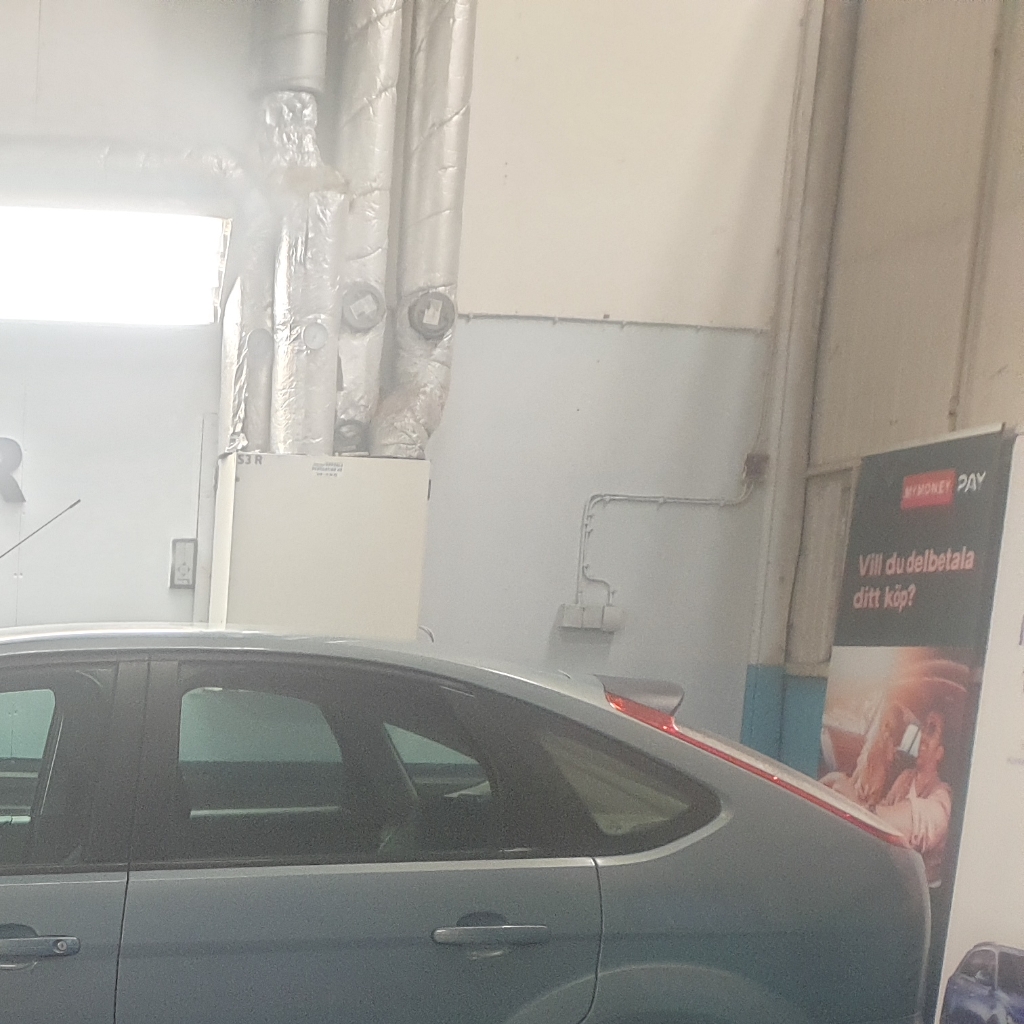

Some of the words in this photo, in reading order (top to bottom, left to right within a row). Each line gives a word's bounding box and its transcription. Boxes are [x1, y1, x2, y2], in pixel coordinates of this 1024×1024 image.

[957, 471, 987, 493] PAY
[859, 552, 883, 576] Vill
[885, 550, 905, 575] du
[906, 546, 975, 573] delbetala
[853, 585, 881, 609] ditt
[883, 583, 917, 612] köp?
